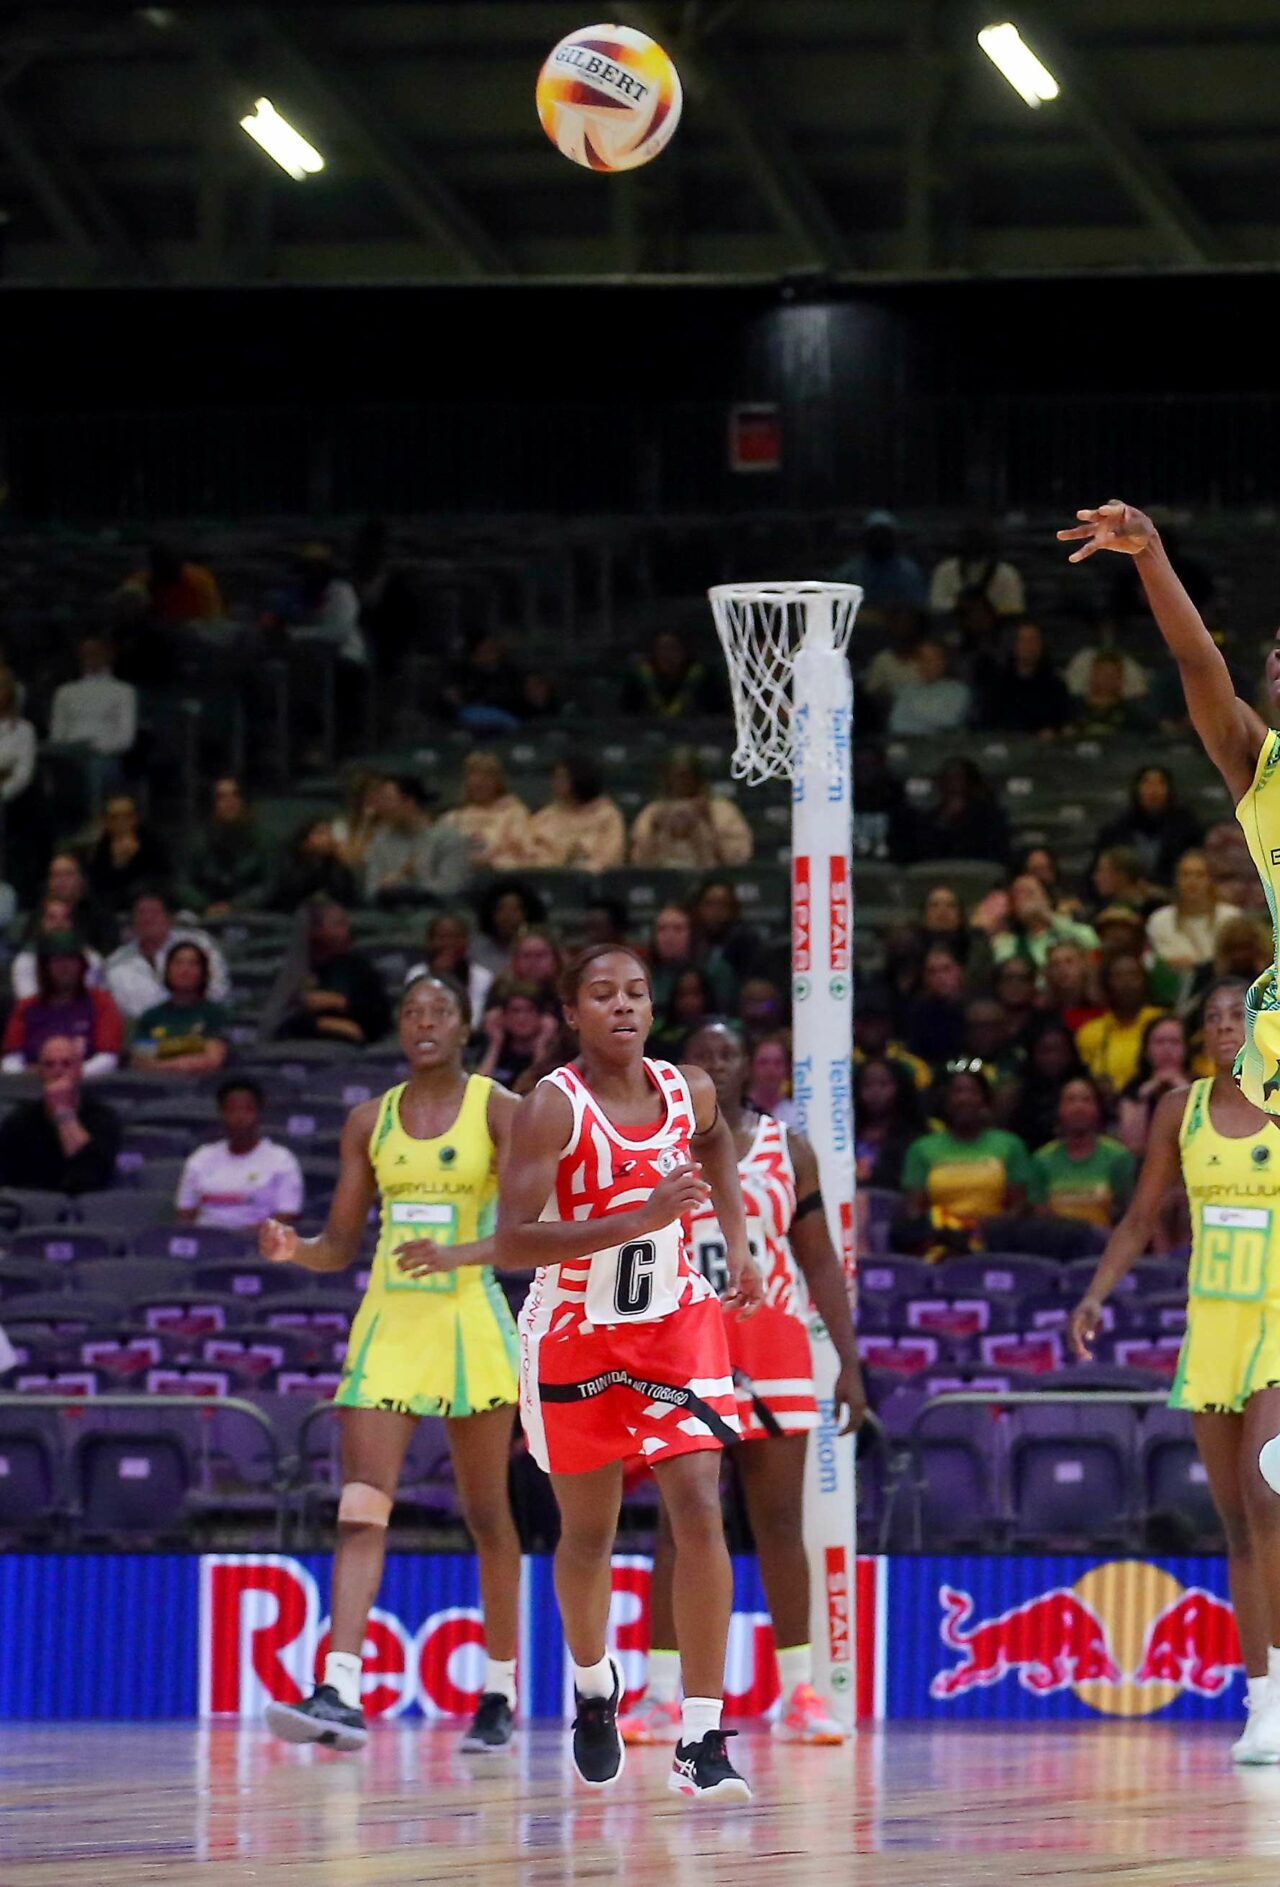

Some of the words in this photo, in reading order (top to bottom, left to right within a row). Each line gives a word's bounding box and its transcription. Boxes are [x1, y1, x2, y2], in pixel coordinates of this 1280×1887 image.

[556, 47, 649, 102] GILBERT
[794, 1055, 812, 1137] Telko
[831, 1058, 849, 1152] Telkom
[614, 1240, 656, 1316] C
[1202, 1230, 1266, 1295] GD
[577, 1370, 632, 1398] TRINIDA
